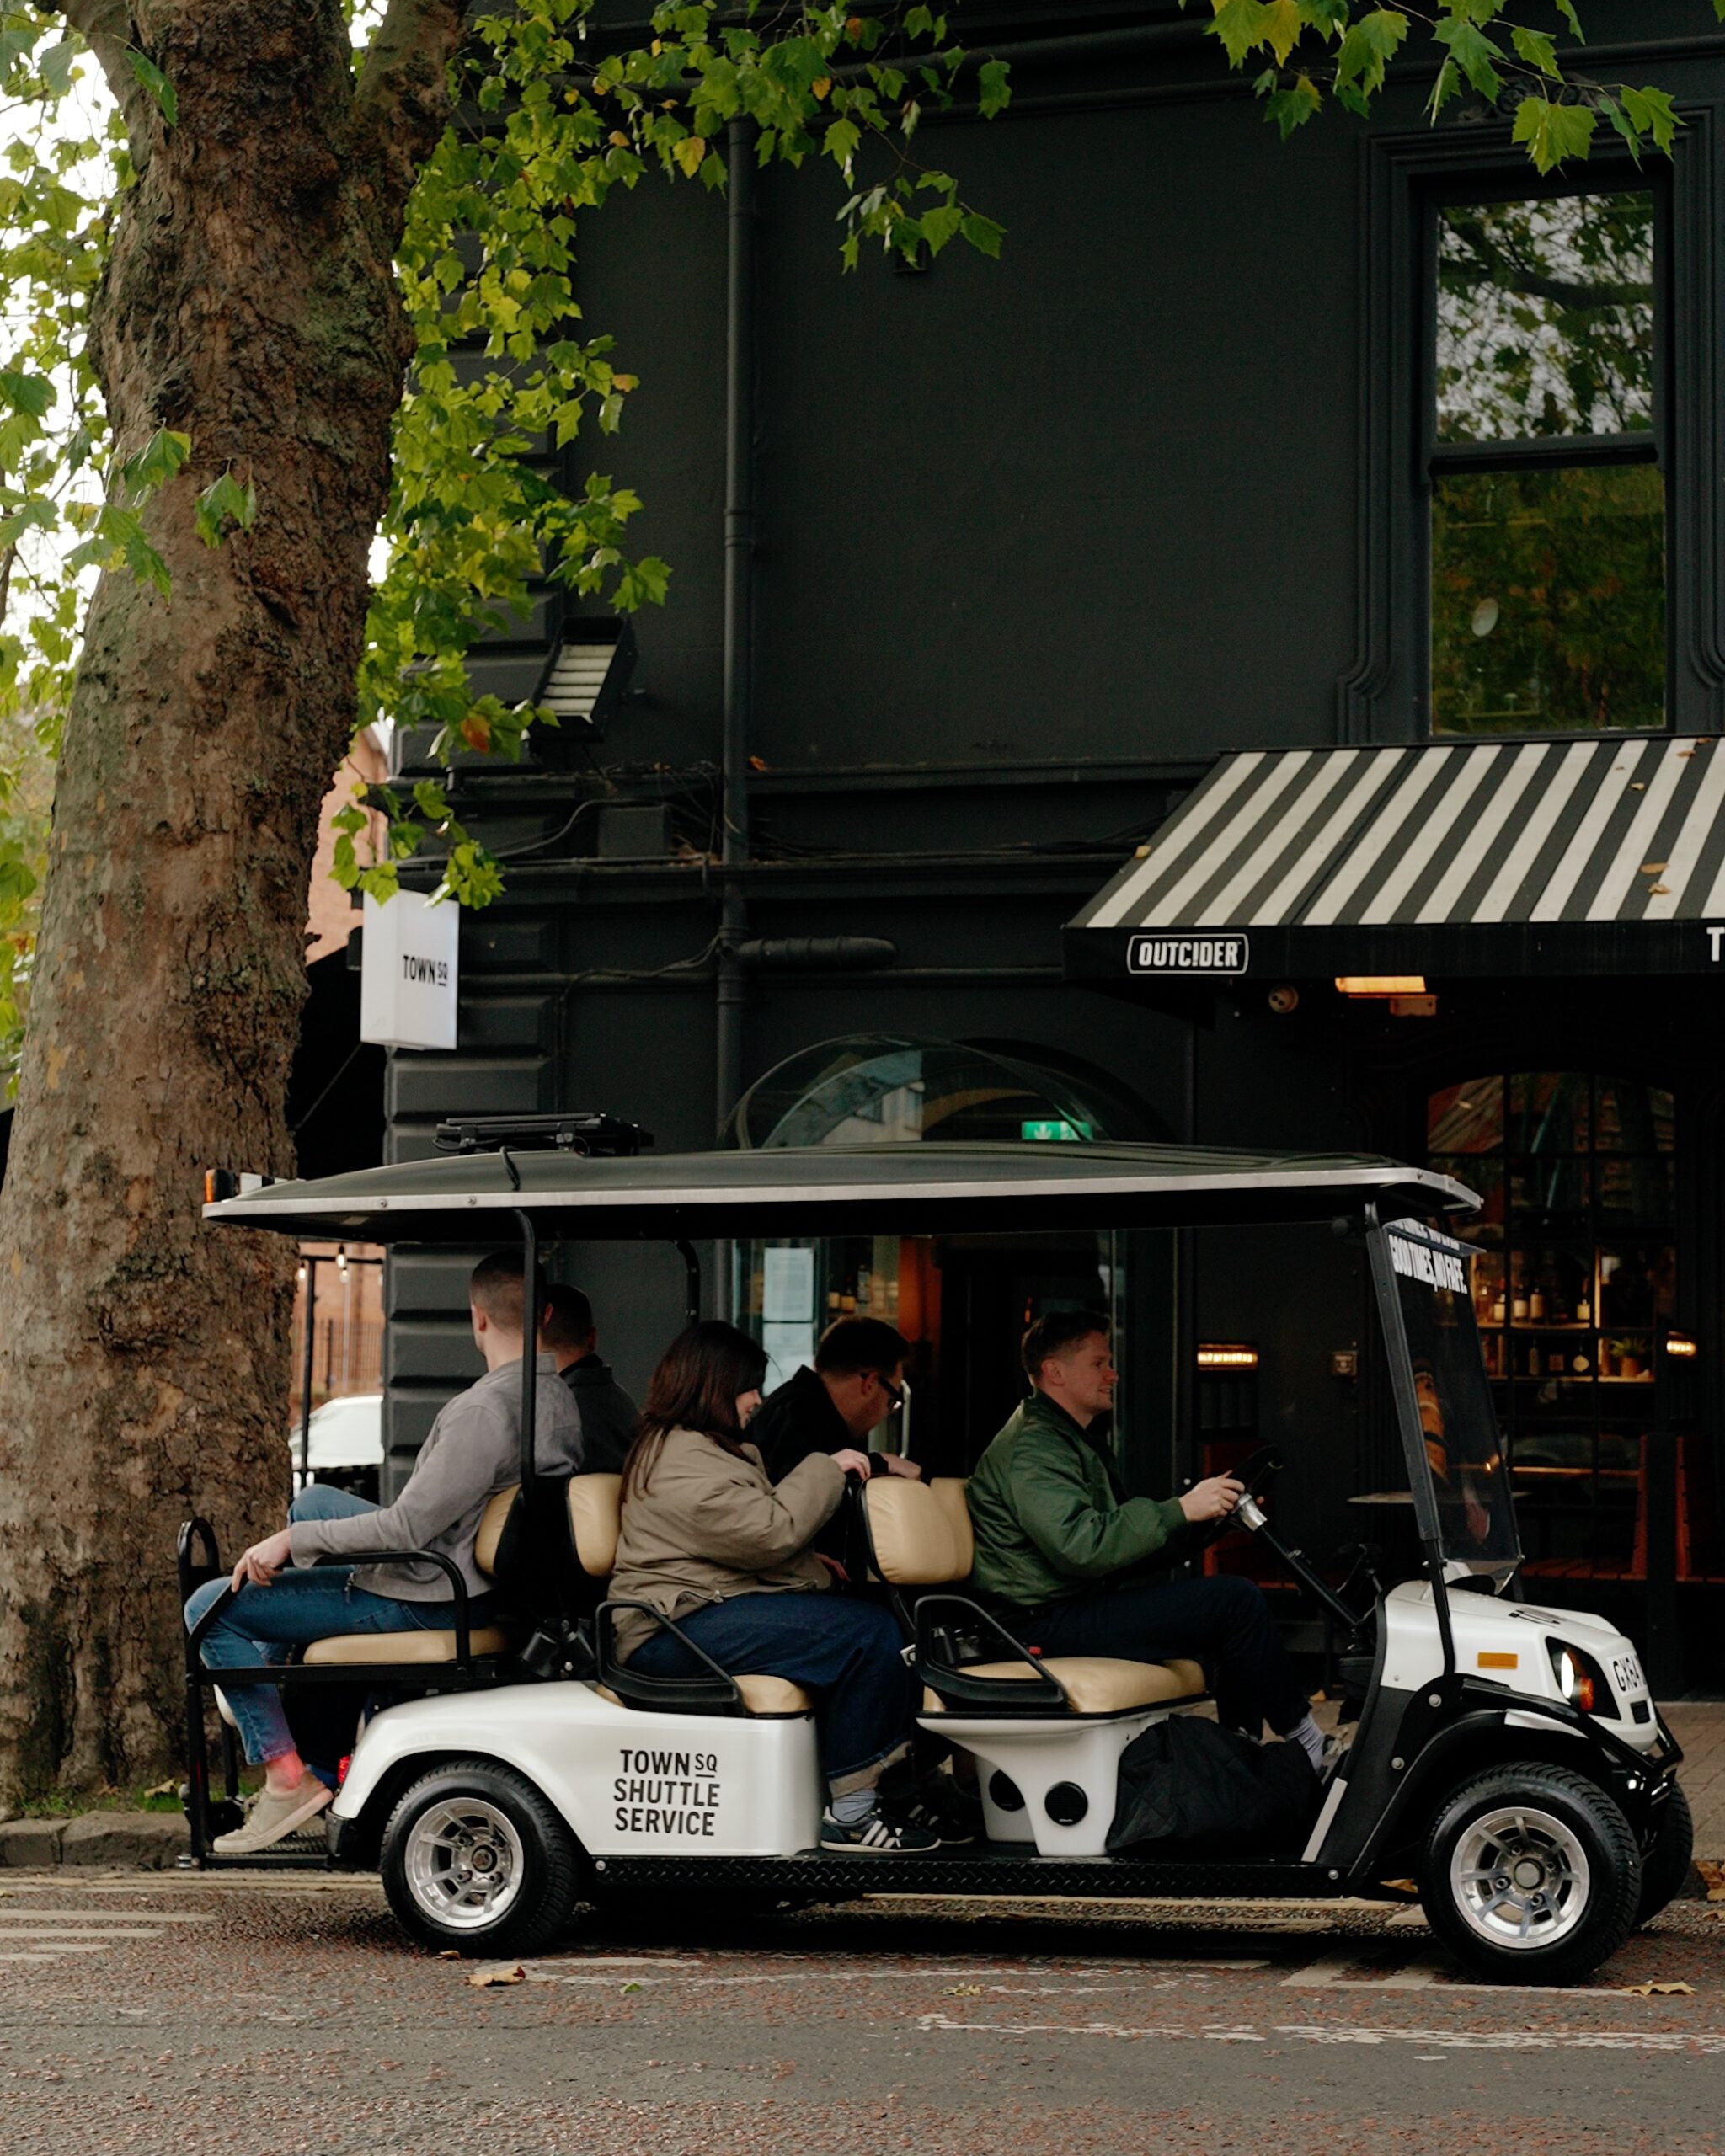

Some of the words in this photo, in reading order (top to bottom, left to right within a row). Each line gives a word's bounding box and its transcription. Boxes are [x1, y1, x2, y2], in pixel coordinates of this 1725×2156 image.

[403, 954, 436, 985] TOWN
[437, 962, 448, 984] SQ
[620, 1749, 690, 1777] TOWN
[694, 1753, 718, 1773] SQ
[613, 1778, 721, 1808] SHUTTLE
[614, 1806, 715, 1837] SERVICE
